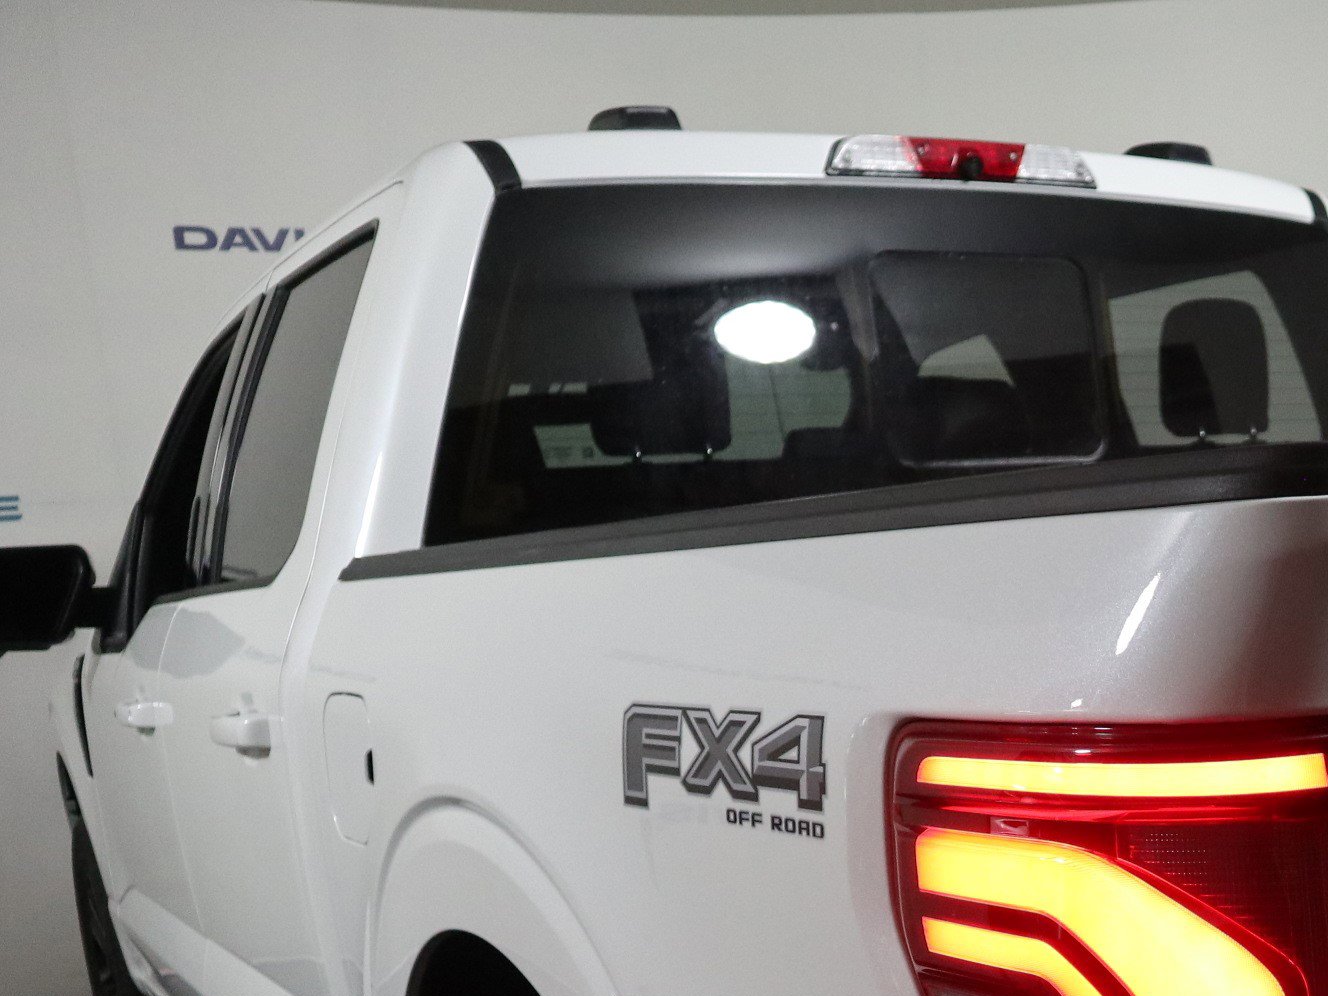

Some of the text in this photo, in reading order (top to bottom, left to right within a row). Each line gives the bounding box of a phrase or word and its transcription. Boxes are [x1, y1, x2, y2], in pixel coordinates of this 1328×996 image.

[622, 703, 826, 811] FX4
[726, 808, 825, 839] OFF ROAD
